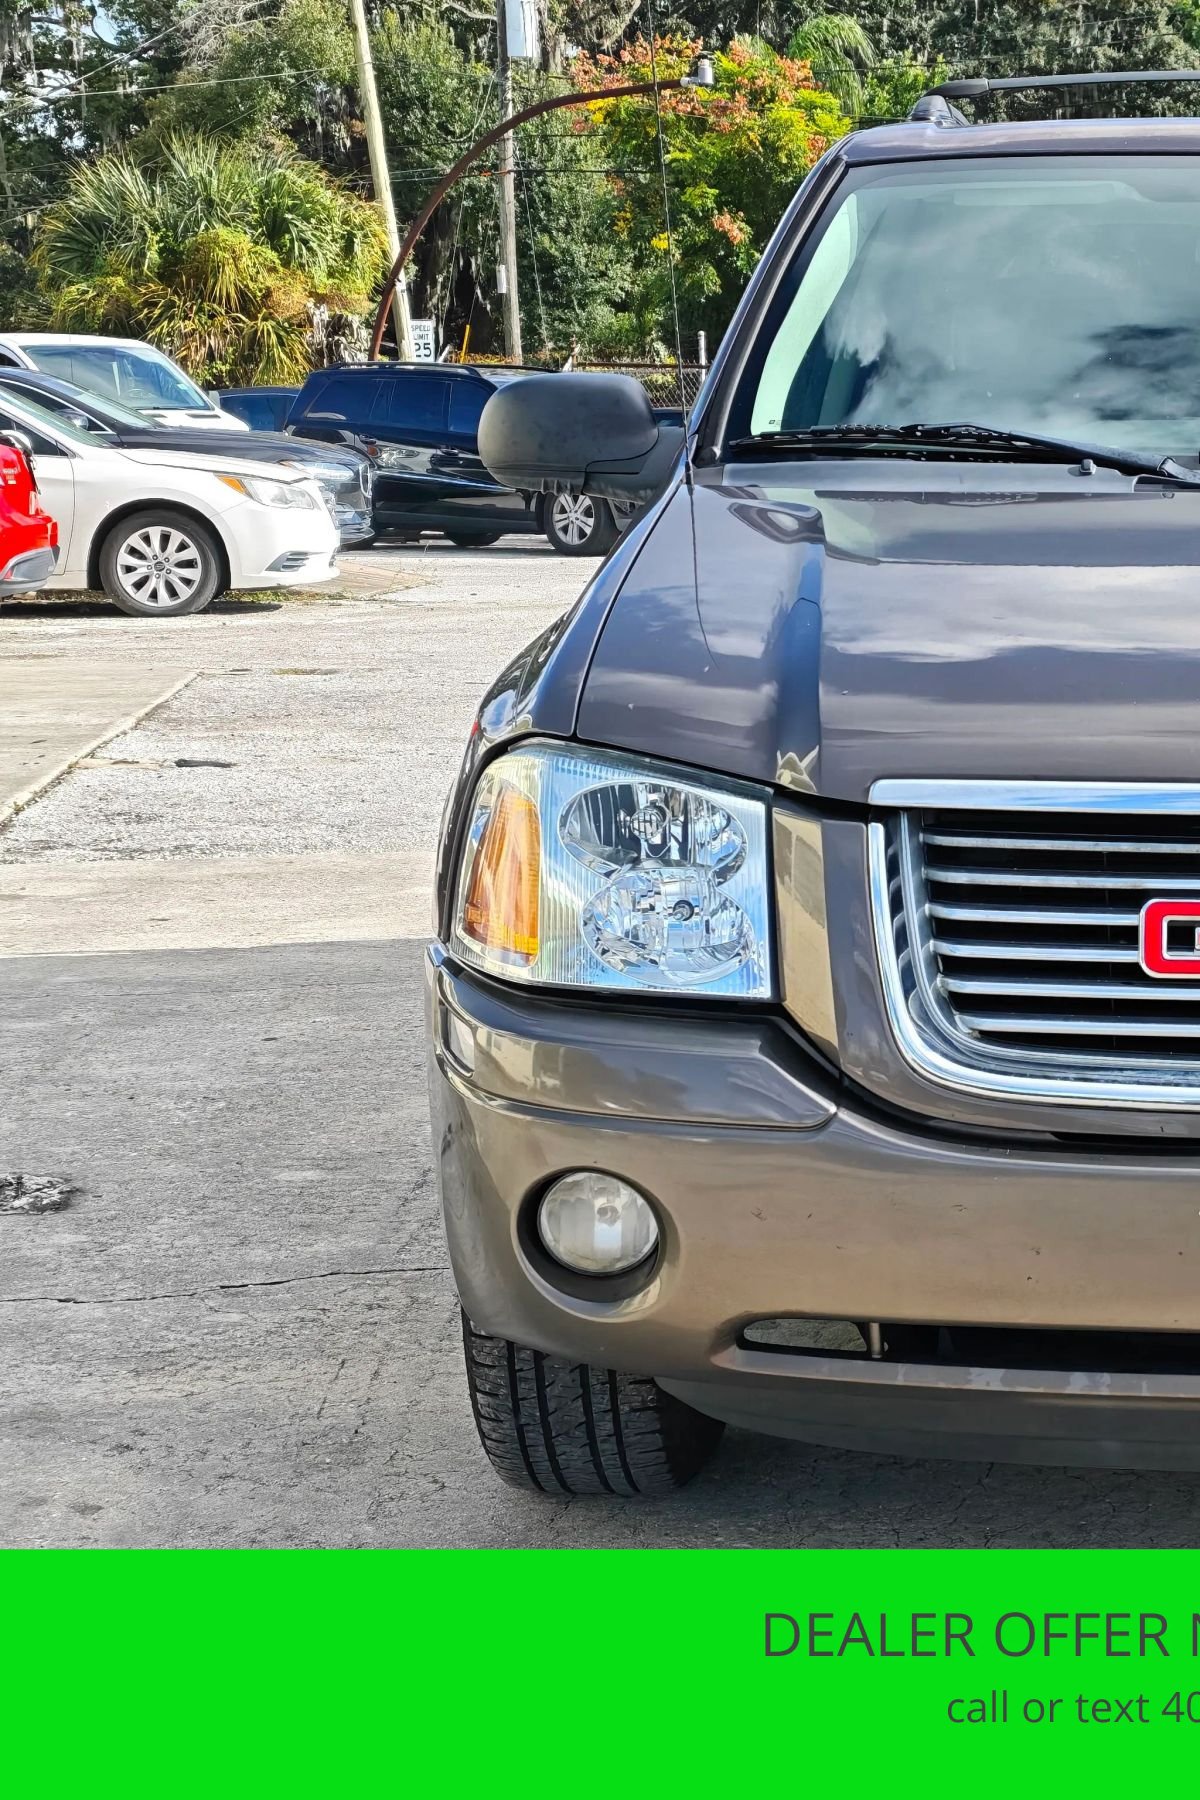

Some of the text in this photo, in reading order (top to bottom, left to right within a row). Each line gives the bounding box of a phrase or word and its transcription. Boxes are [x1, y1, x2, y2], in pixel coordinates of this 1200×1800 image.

[410, 324, 431, 332] SPEED
[413, 333, 430, 341] LIMIT
[414, 342, 432, 358] 25
